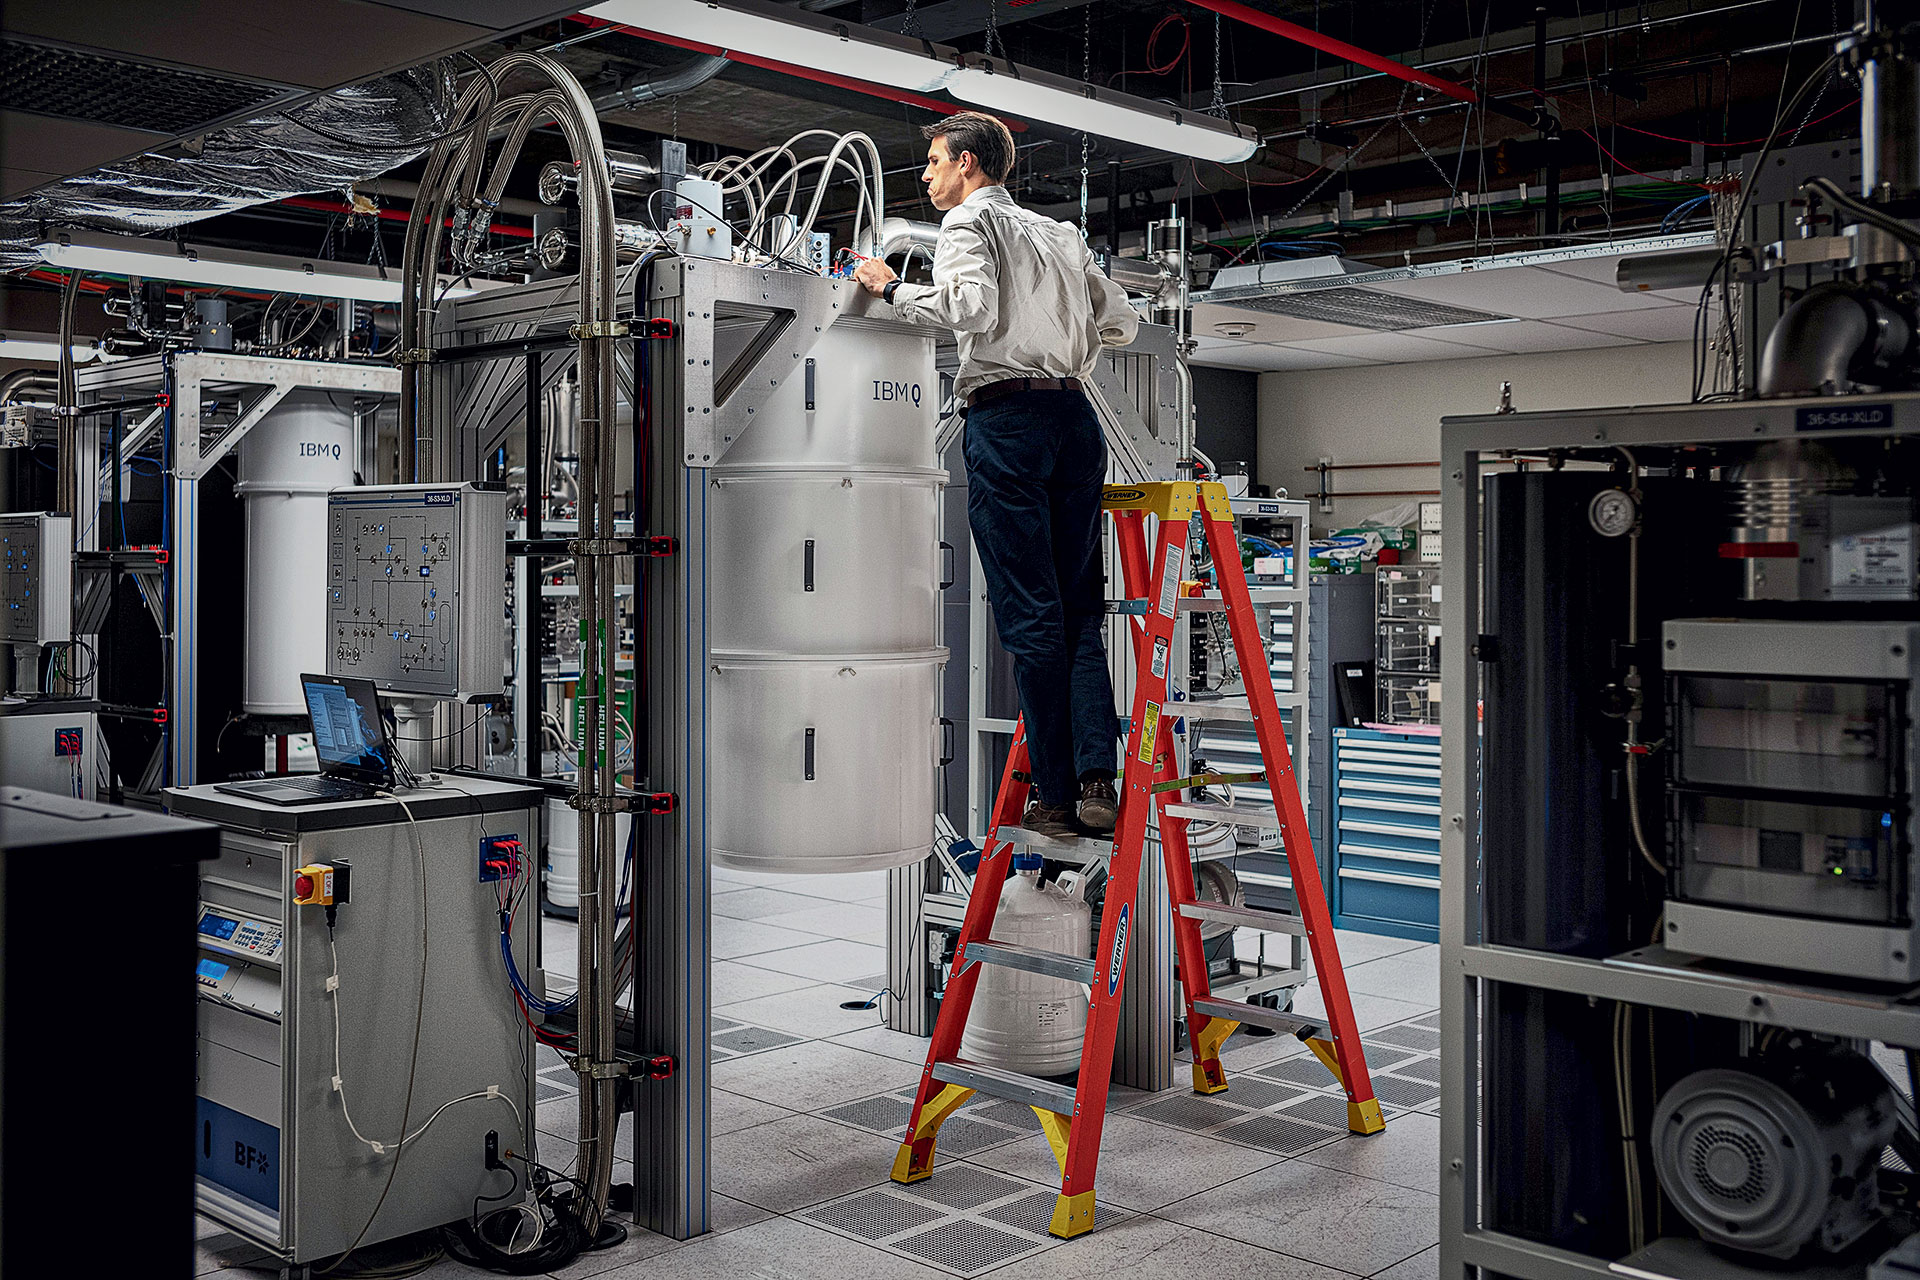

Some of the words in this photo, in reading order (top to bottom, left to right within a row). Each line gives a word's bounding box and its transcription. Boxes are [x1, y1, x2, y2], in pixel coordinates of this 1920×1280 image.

[873, 380, 908, 402] IBM
[911, 383, 921, 408] Q
[300, 442, 329, 457] IBM
[332, 444, 341, 460] Q
[598, 704, 606, 751] HELIUM
[1112, 921, 1126, 976] WERNER
[235, 1141, 256, 1169] BF
